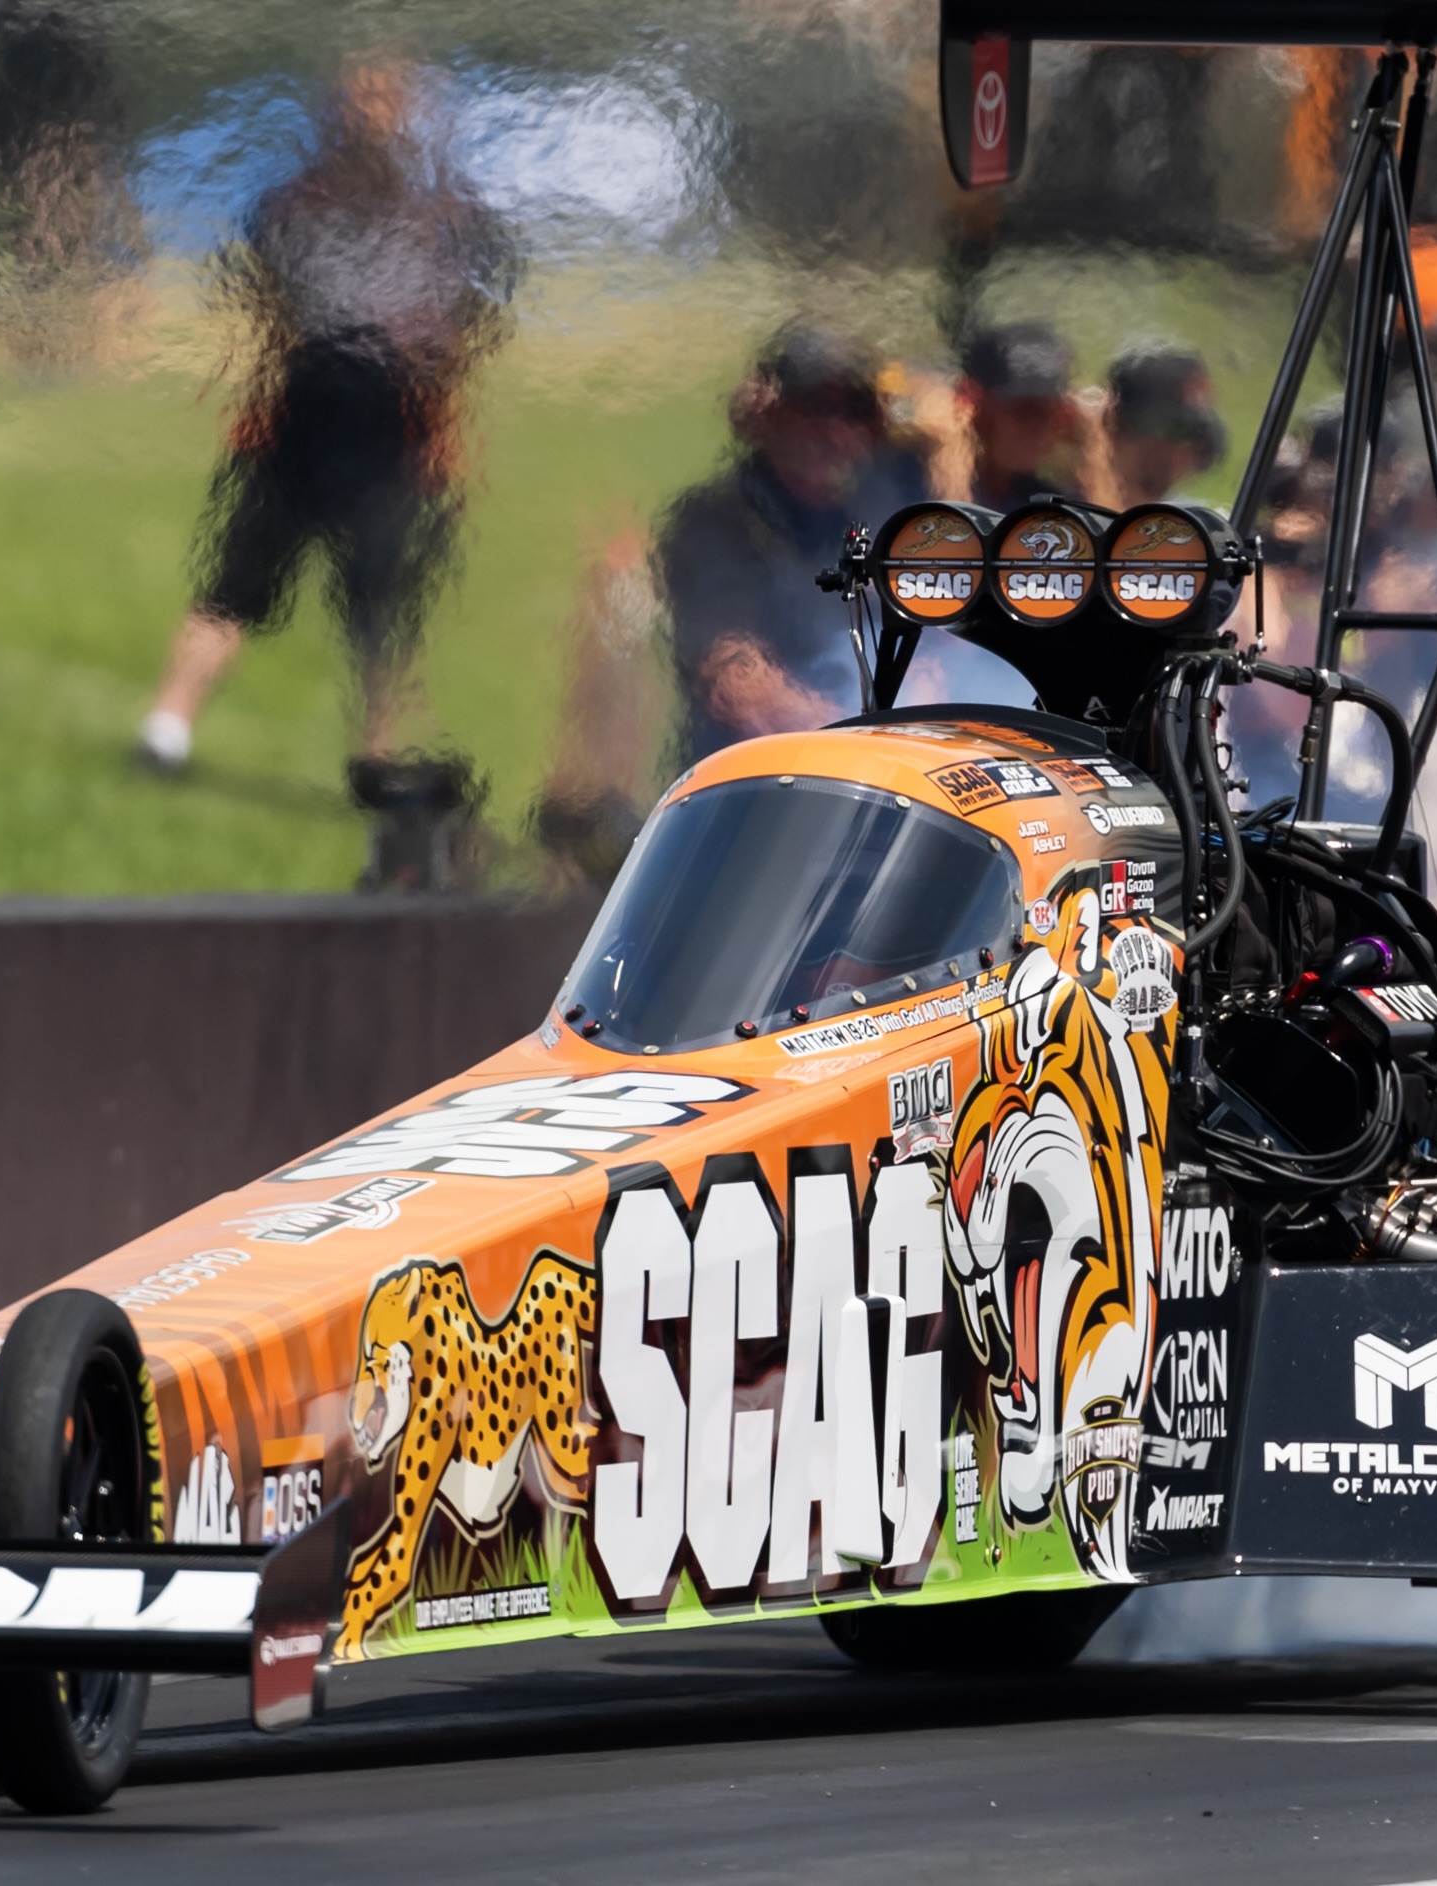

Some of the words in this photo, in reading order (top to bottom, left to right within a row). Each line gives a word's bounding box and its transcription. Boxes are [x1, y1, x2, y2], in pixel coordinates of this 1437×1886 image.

[897, 572, 972, 600] SCAG
[1007, 573, 1083, 600] SCAG
[1119, 573, 1195, 601] SCAG
[938, 764, 992, 797] SCAG
[1110, 806, 1165, 827] BLUEBIRD
[1101, 882, 1126, 912] GR
[1034, 905, 1051, 924] RFC
[782, 1025, 847, 1055] MATTHEW
[844, 1014, 880, 1043] 19:26
[875, 1008, 903, 1034] With
[899, 1007, 923, 1028] God
[922, 1001, 936, 1022] All
[933, 996, 965, 1018] Things
[1161, 1206, 1231, 1299] KATO
[594, 1162, 944, 1600] SCAG
[1178, 1328, 1227, 1404] RCN
[1177, 1406, 1227, 1440] CAPITAL
[1067, 1432, 1093, 1477] HOT
[1095, 1425, 1138, 1463] SHOTS
[1087, 1469, 1115, 1503] PUB
[1332, 1477, 1362, 1494] OF
[263, 1468, 322, 1539] BOSS
